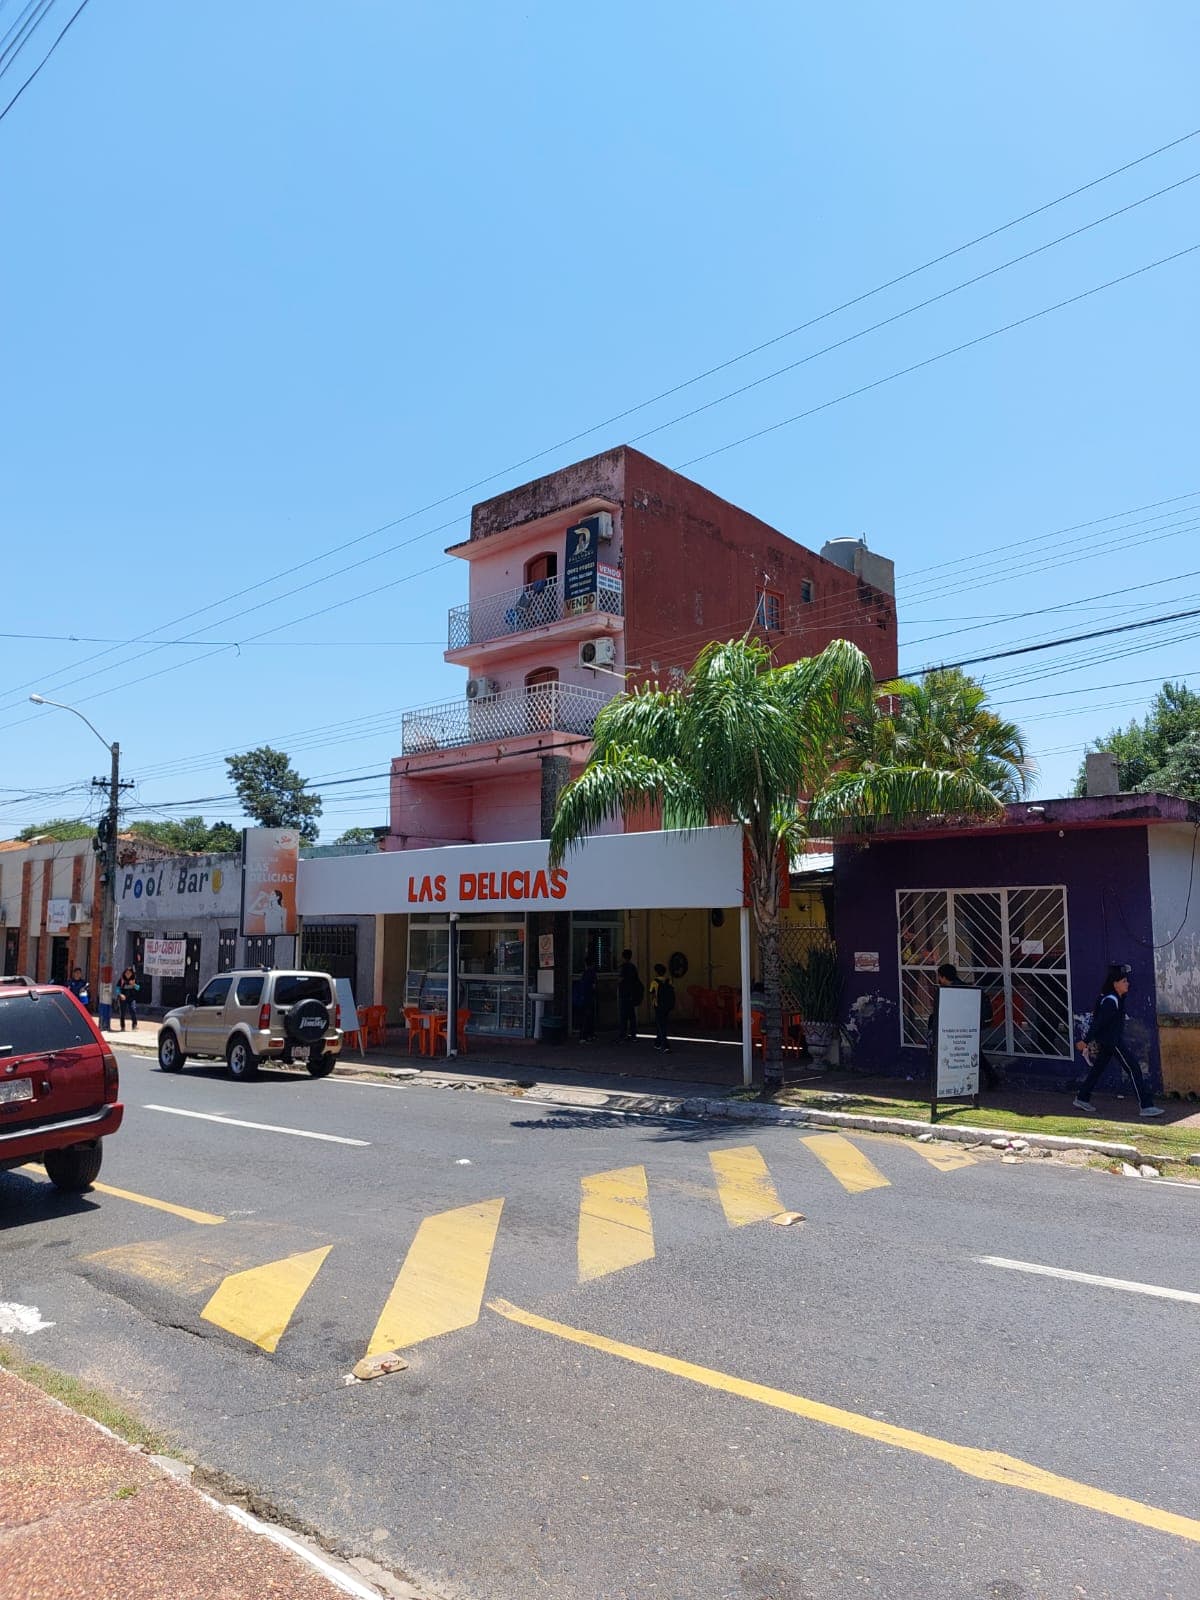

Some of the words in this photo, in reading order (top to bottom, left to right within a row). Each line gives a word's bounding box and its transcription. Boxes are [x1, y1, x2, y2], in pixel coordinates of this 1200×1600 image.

[599, 565, 621, 578] VENDO
[566, 594, 595, 610] VENDO
[177, 867, 209, 894] Bar
[249, 873, 295, 883] DELICIAS
[408, 874, 446, 902] LAS
[459, 868, 568, 900] DELICIAS
